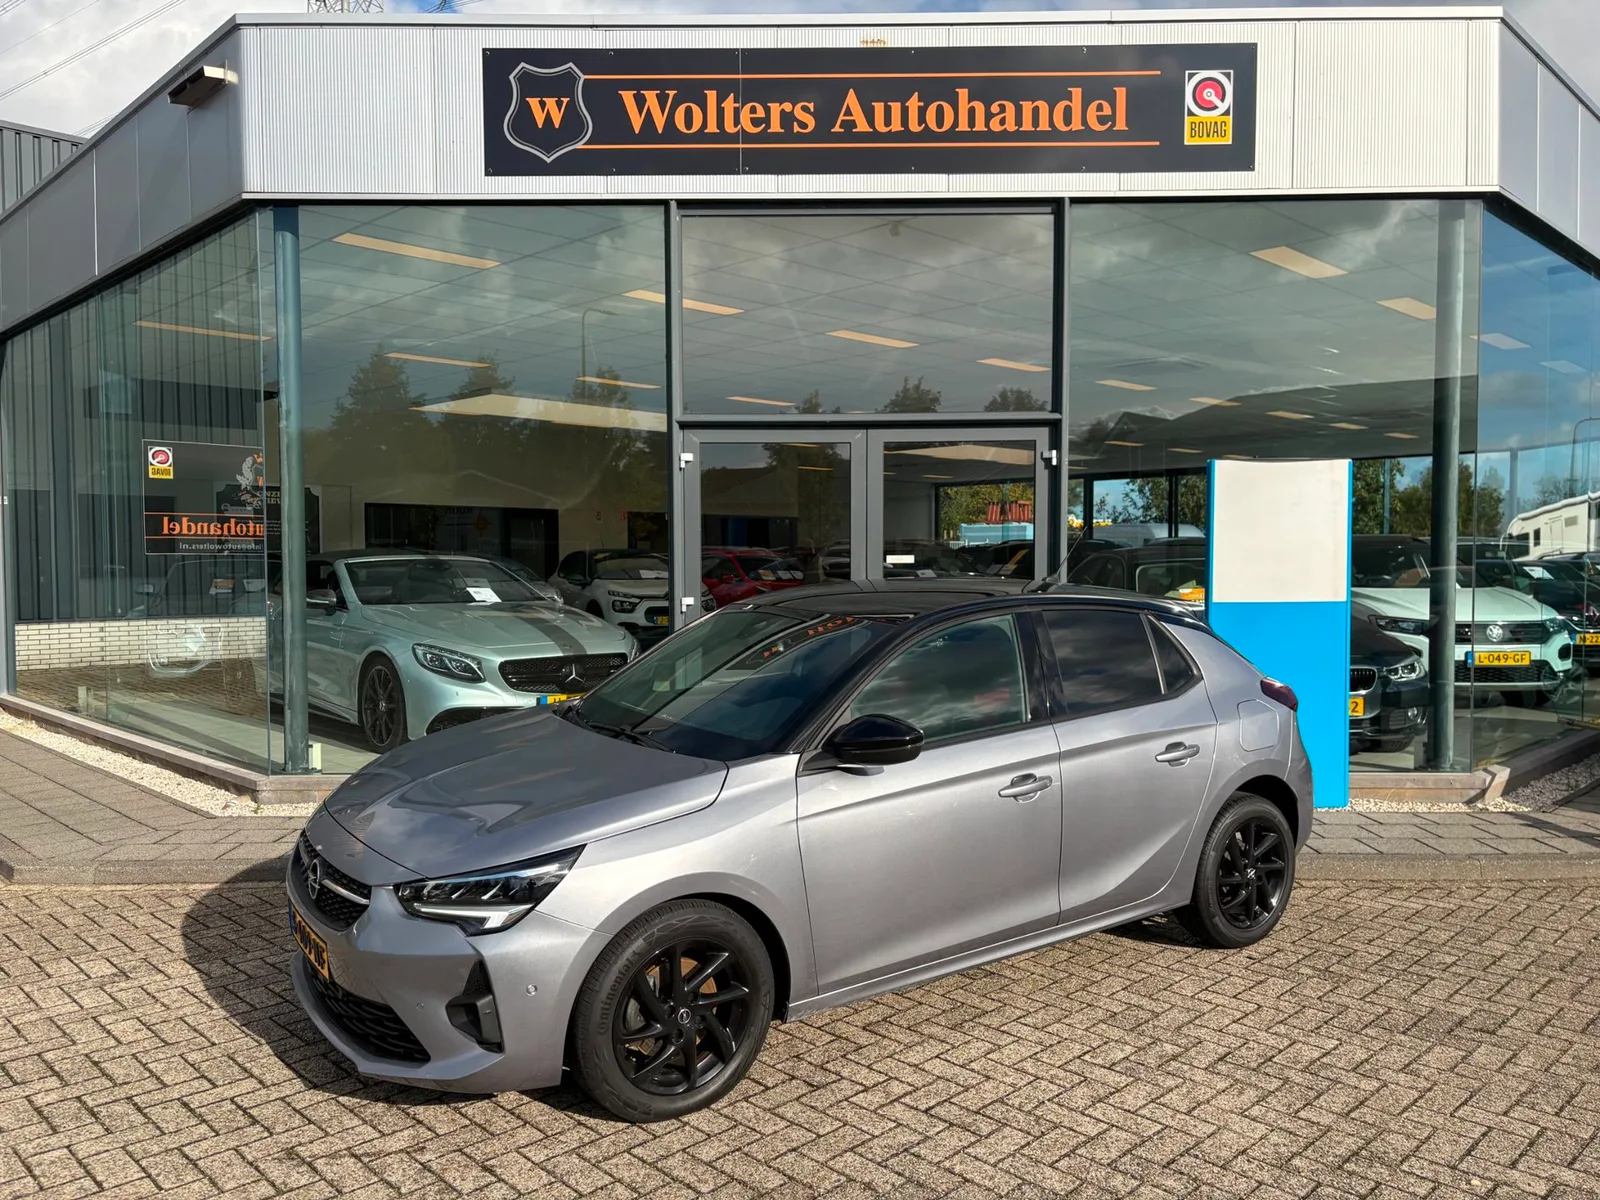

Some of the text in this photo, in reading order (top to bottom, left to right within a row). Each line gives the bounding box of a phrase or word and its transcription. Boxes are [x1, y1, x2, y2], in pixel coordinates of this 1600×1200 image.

[525, 97, 570, 129] W
[618, 86, 1129, 134] Wolters Autohandel
[1190, 121, 1227, 138] BOVAG
[1478, 654, 1527, 663] L-049-GF
